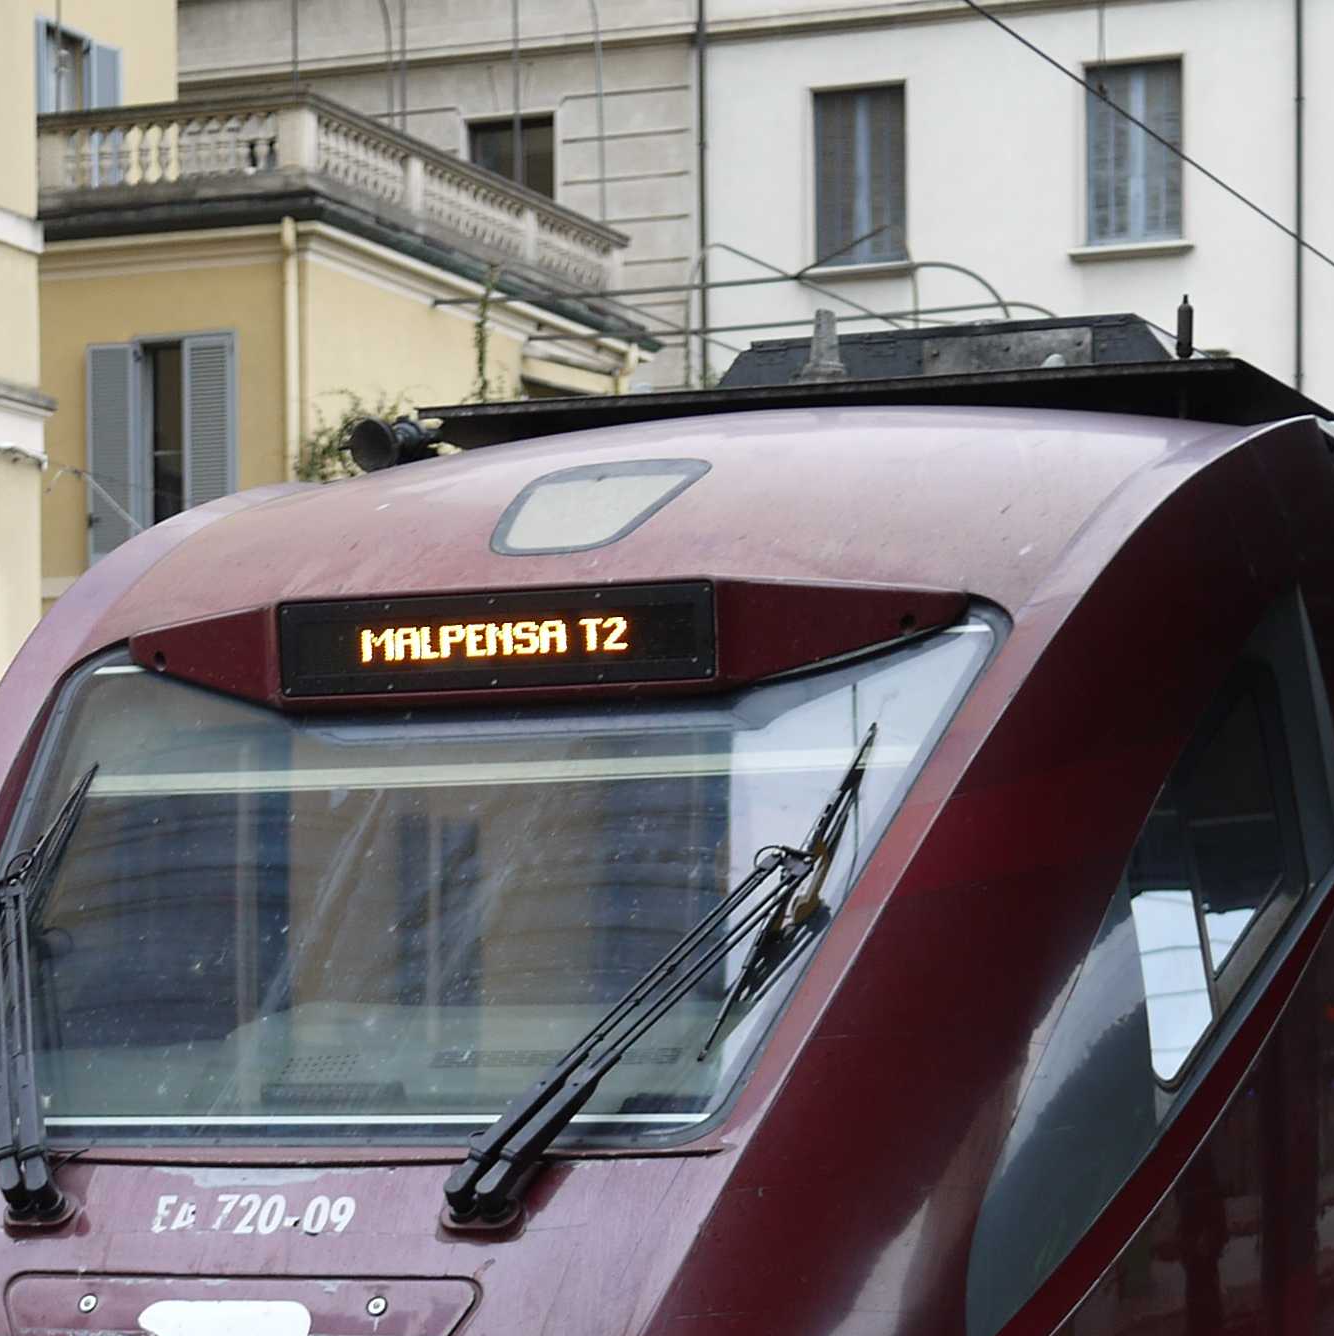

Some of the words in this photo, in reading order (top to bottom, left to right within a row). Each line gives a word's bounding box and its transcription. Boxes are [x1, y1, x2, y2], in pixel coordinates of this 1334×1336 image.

[361, 620, 567, 662] MALPENSA
[578, 616, 630, 652] T2
[151, 1194, 197, 1233] EA
[212, 1193, 356, 1234] 720-09
